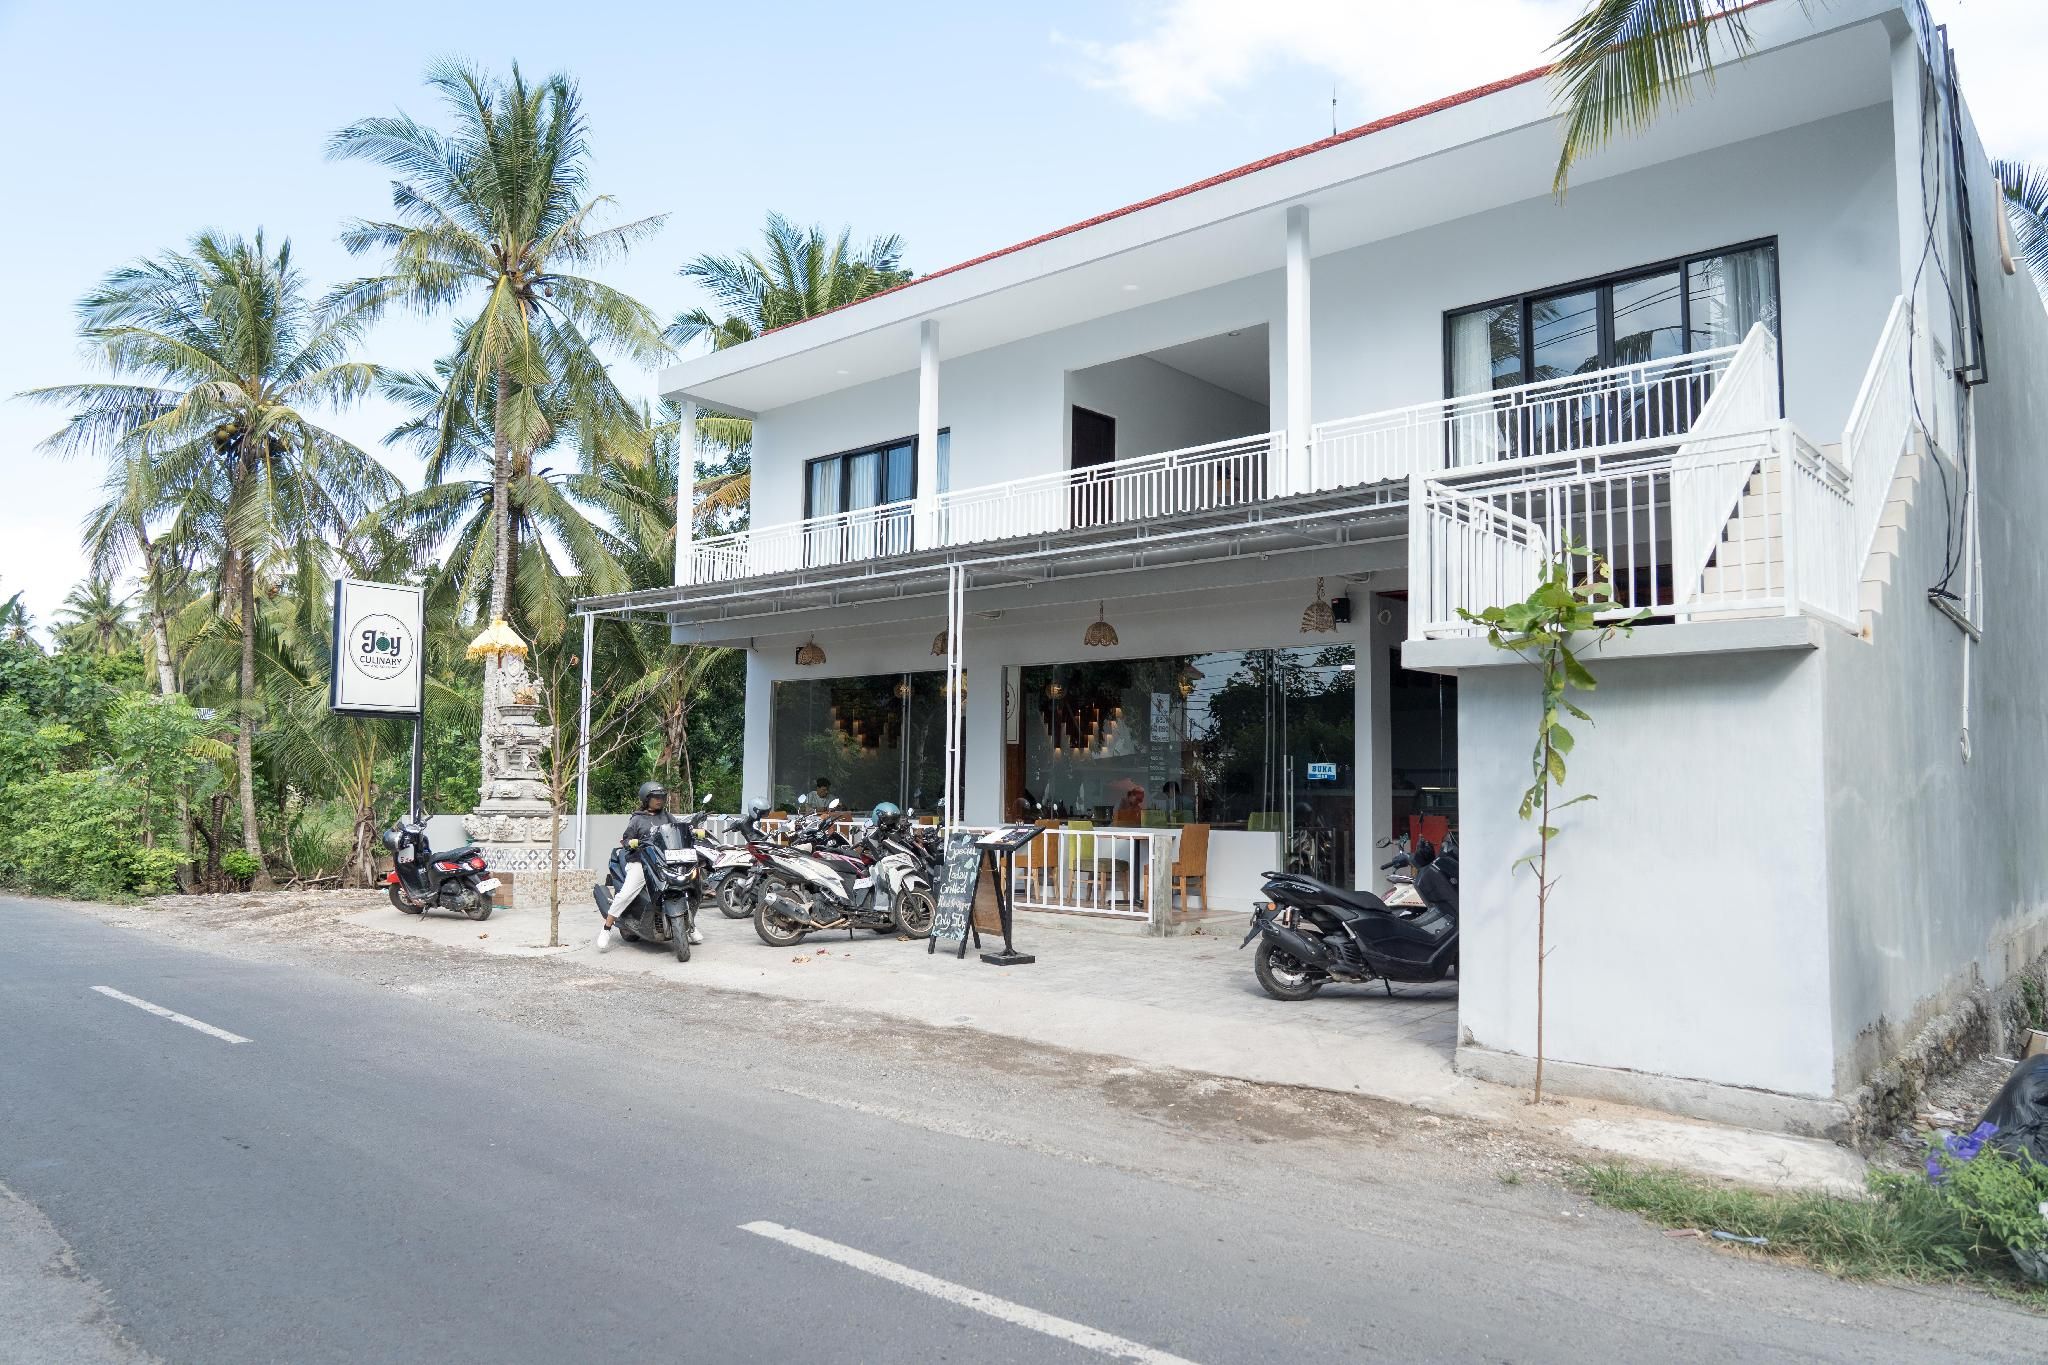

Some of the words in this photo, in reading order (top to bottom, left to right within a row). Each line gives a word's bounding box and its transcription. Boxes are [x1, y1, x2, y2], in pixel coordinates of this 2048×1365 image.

[360, 656, 402, 665] CULINARY
[947, 840, 977, 860] Special
[948, 864, 969, 885] Today
[940, 882, 967, 894] Grilled
[934, 912, 951, 930] Only
